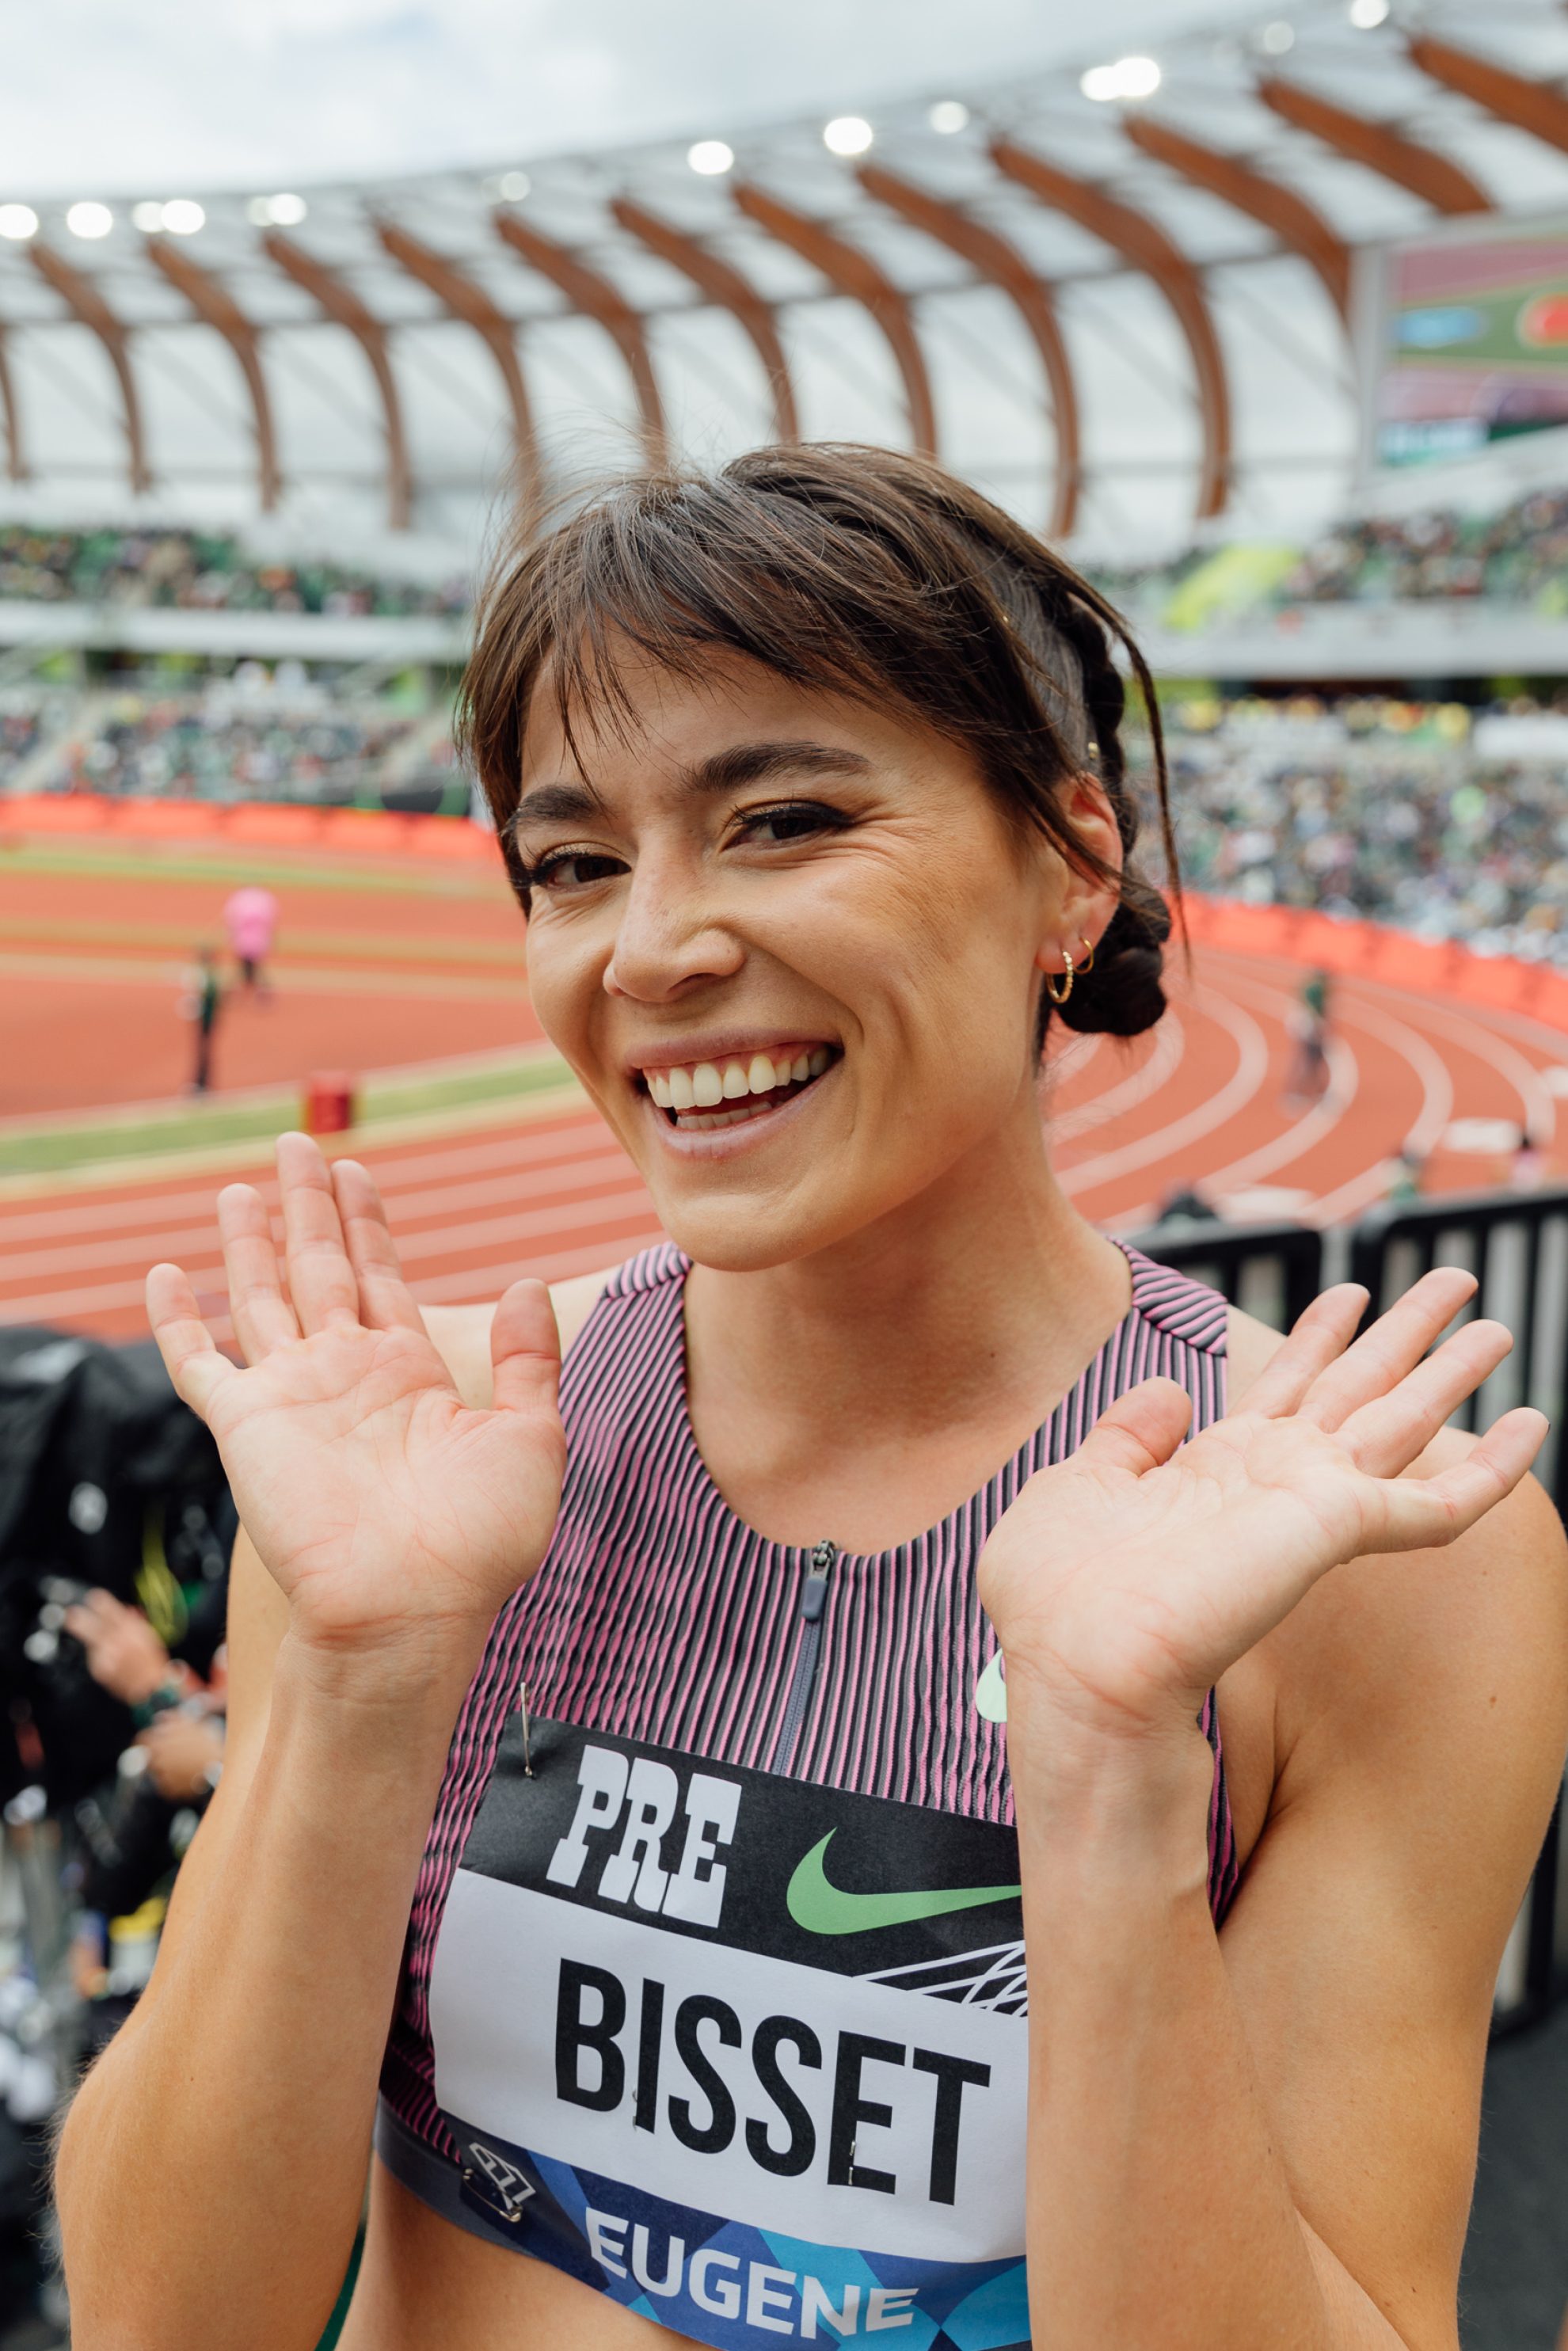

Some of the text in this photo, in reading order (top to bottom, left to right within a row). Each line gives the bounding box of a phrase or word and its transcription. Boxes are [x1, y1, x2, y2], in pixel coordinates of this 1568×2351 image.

[546, 1745, 742, 1928] PRE
[555, 1958, 991, 2206] BISSET
[585, 2207, 919, 2339] EUGENE
